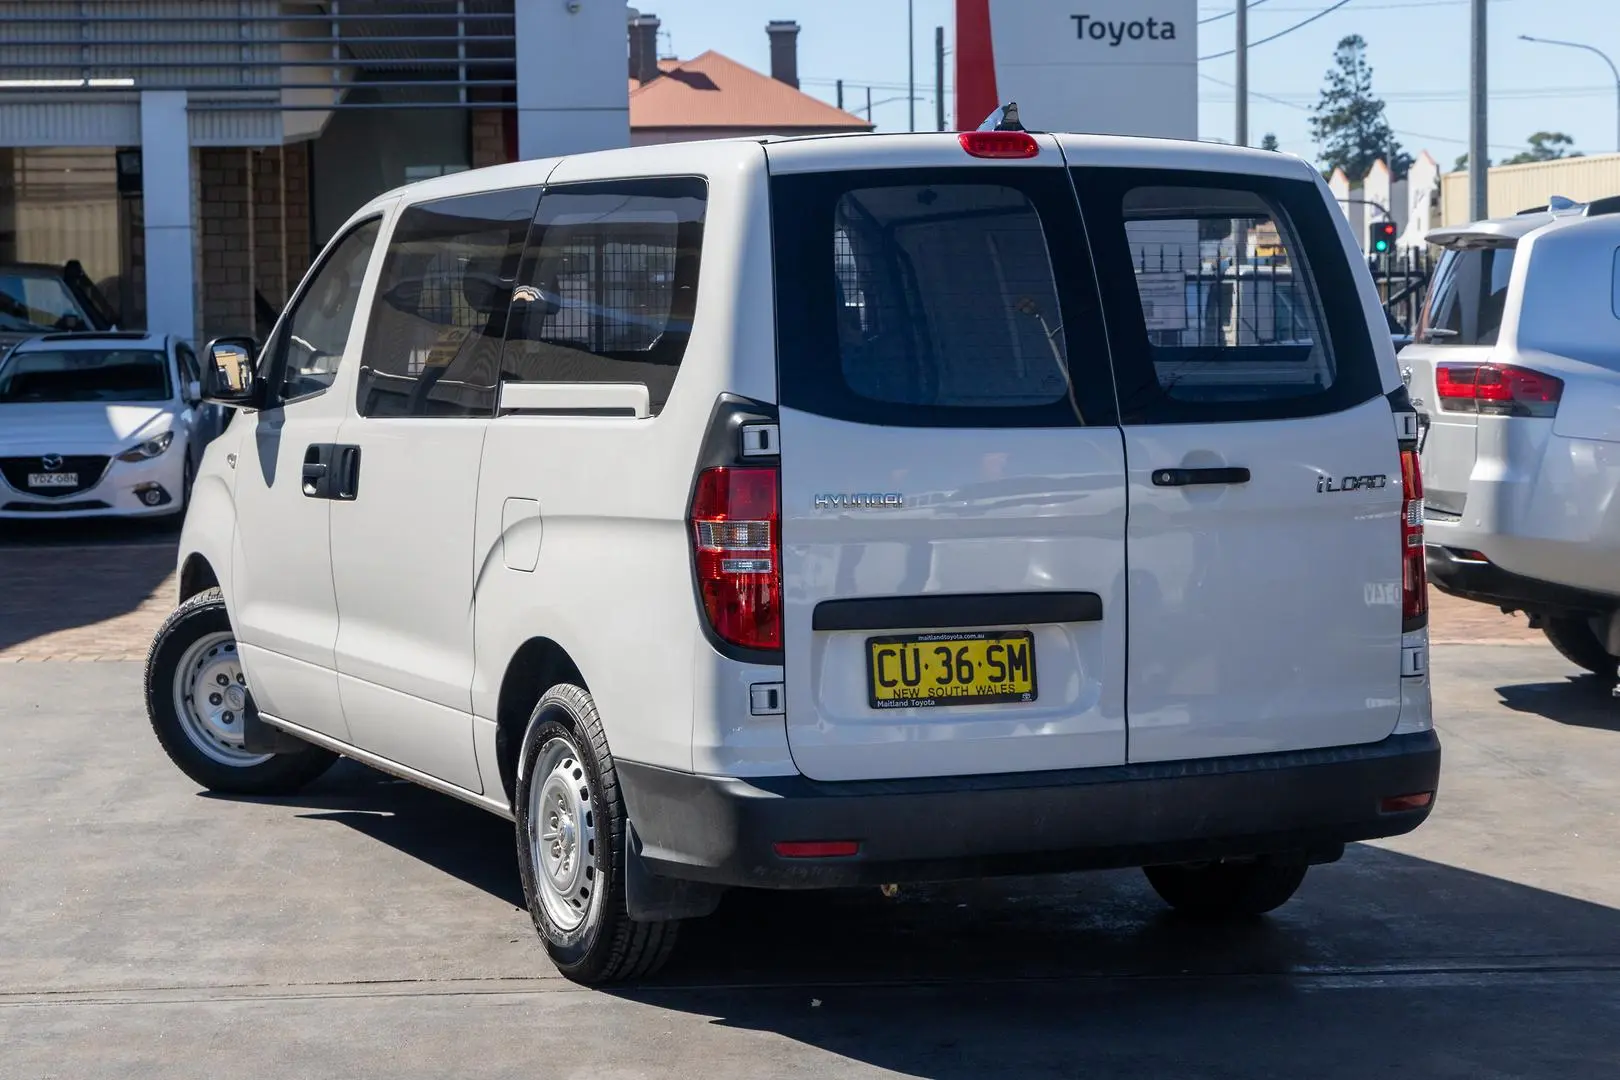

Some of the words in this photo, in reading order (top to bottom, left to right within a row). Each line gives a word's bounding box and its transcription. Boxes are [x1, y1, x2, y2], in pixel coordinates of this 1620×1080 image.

[1070, 14, 1176, 47] Toyota
[814, 493, 903, 509] HYUNDAI
[918, 633, 985, 641] maitlandtoyota.com.au
[893, 688, 920, 699] NEW
[927, 686, 969, 698] SOUTH
[975, 683, 1016, 695] WALES
[911, 699, 935, 707] Toyota
